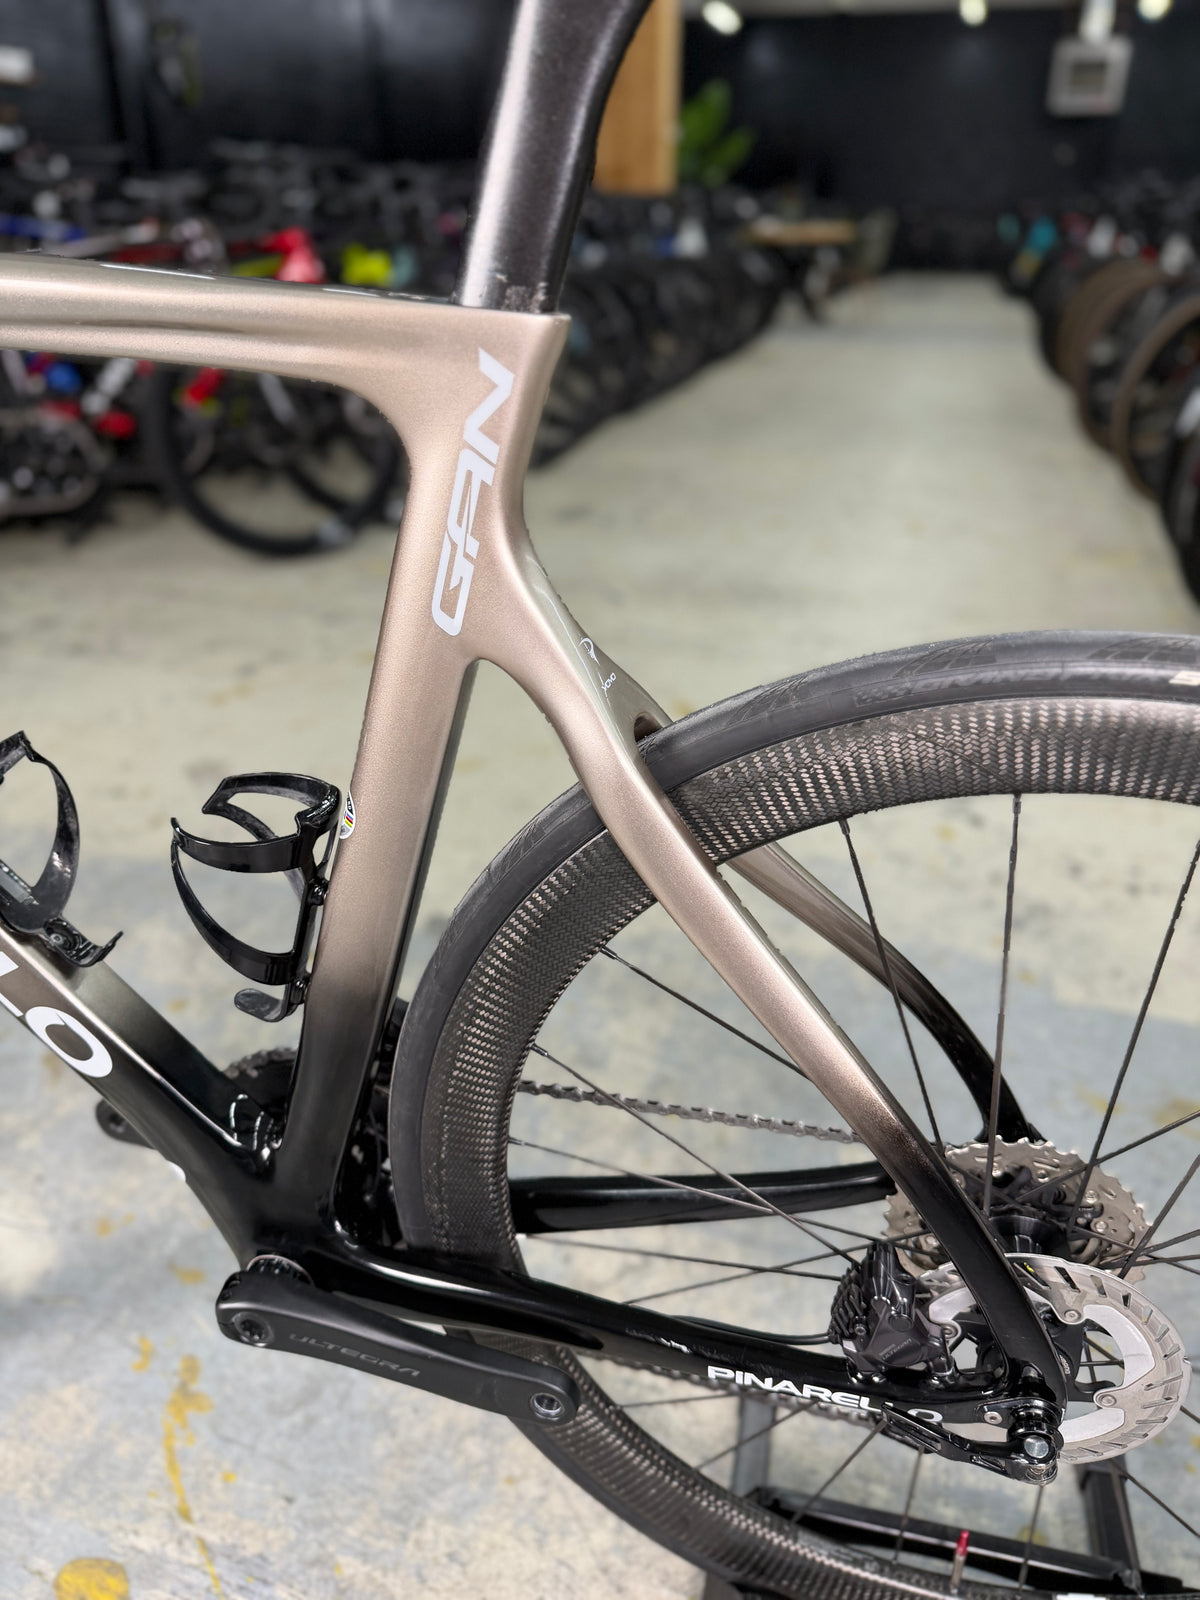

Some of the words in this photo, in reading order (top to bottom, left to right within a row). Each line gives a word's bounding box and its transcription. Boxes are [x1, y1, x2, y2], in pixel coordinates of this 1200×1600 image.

[432, 347, 515, 636] GAN
[289, 1333, 420, 1377] ULTEGRA
[707, 1365, 943, 1423] PINARELO
